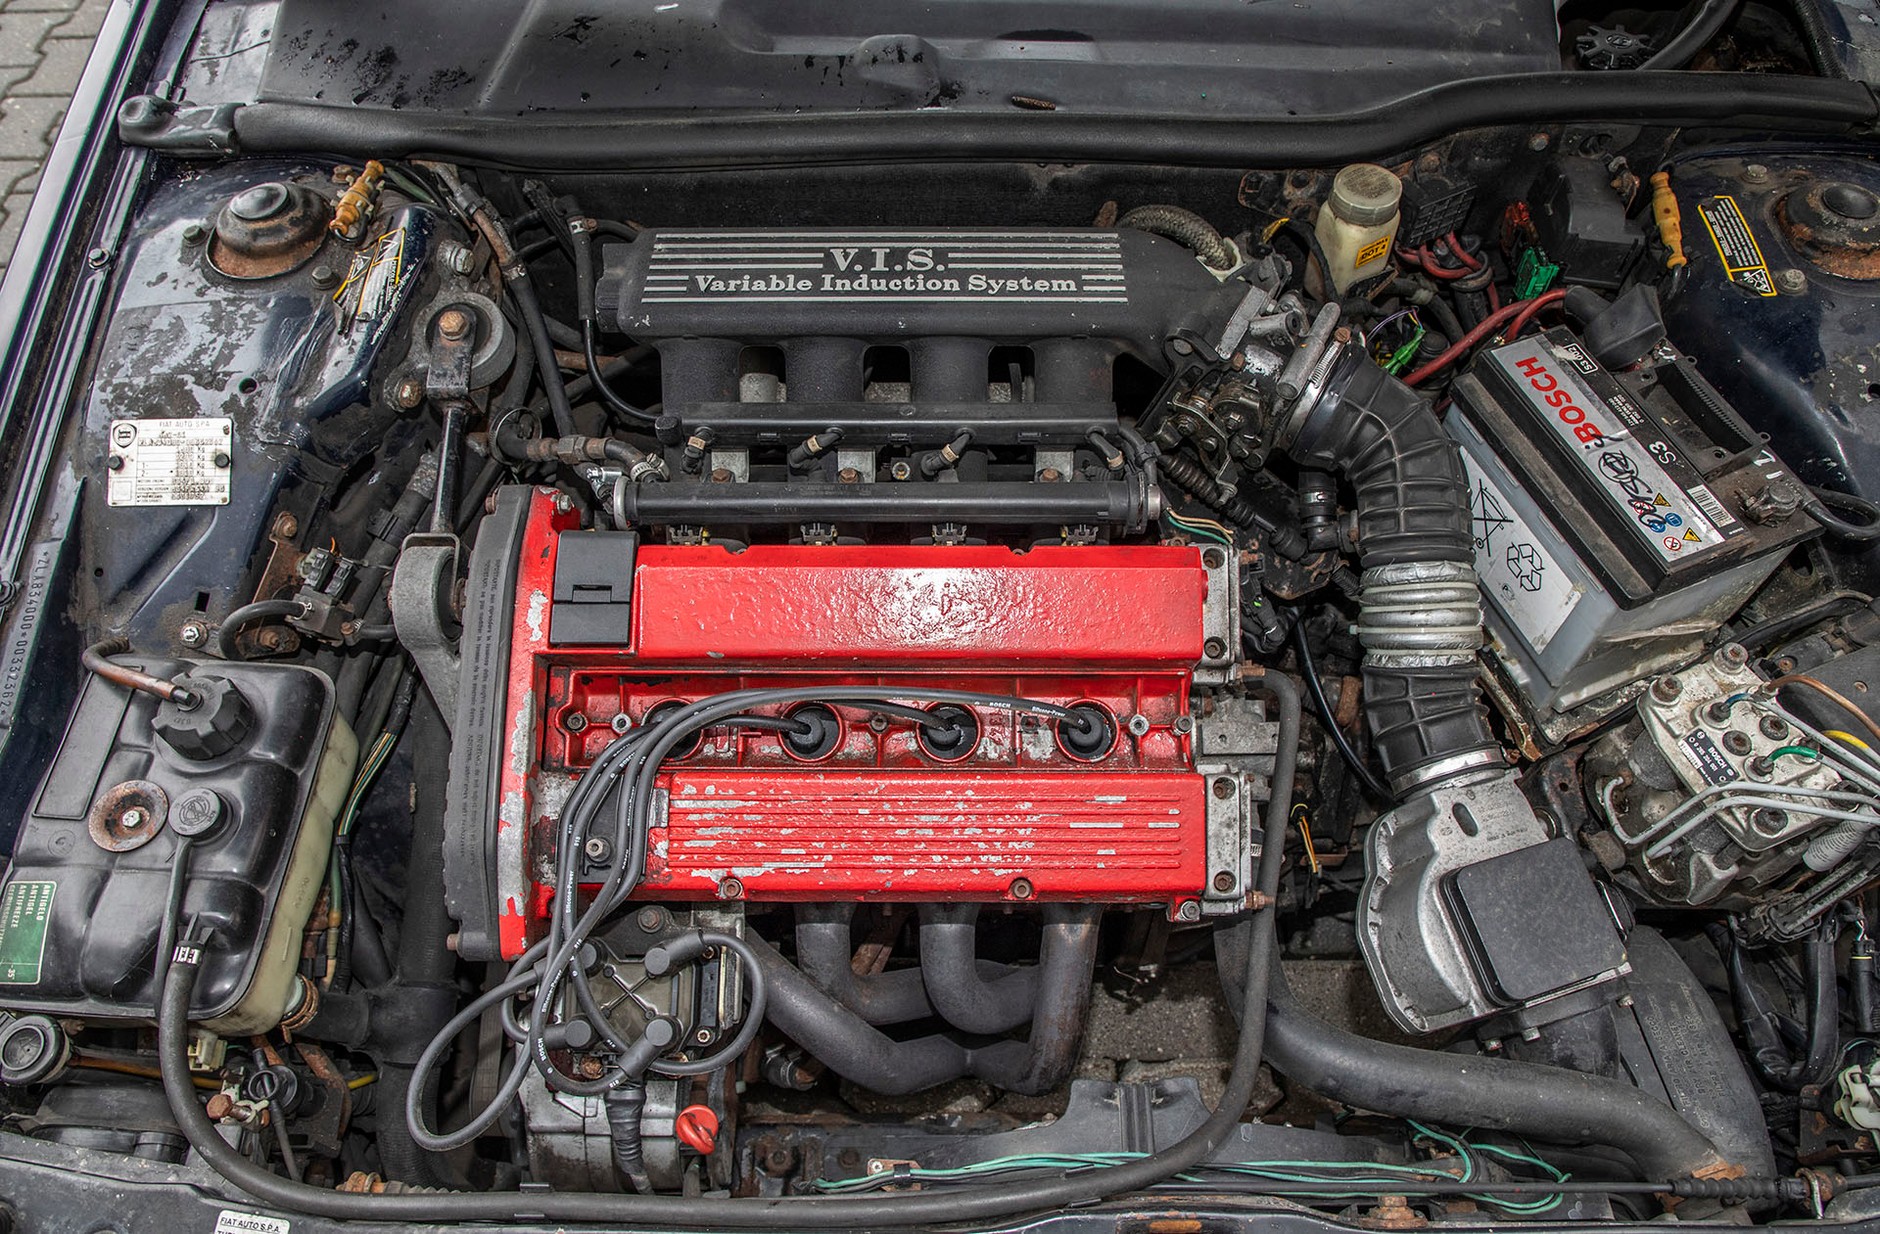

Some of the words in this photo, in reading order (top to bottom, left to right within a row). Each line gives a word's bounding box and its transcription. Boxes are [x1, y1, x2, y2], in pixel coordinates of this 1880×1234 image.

[829, 248, 945, 272] V.I.S.
[1361, 247, 1380, 259] DOT
[695, 274, 813, 293] Variable
[820, 274, 960, 292] Induction
[968, 274, 1077, 294] System
[1515, 357, 1603, 443] BOSCH
[1649, 441, 1676, 464] S3
[989, 701, 1012, 709] BOSCH
[1708, 746, 1727, 769] BOSCH
[11, 884, 27, 928] ANTIFREEZE
[25, 884, 39, 915] ANTIGEL
[36, 884, 51, 921] ANTIGELO
[538, 1038, 546, 1061] BOSCH
[220, 1217, 237, 1225] FIAT
[238, 1220, 259, 1230] AUTO
